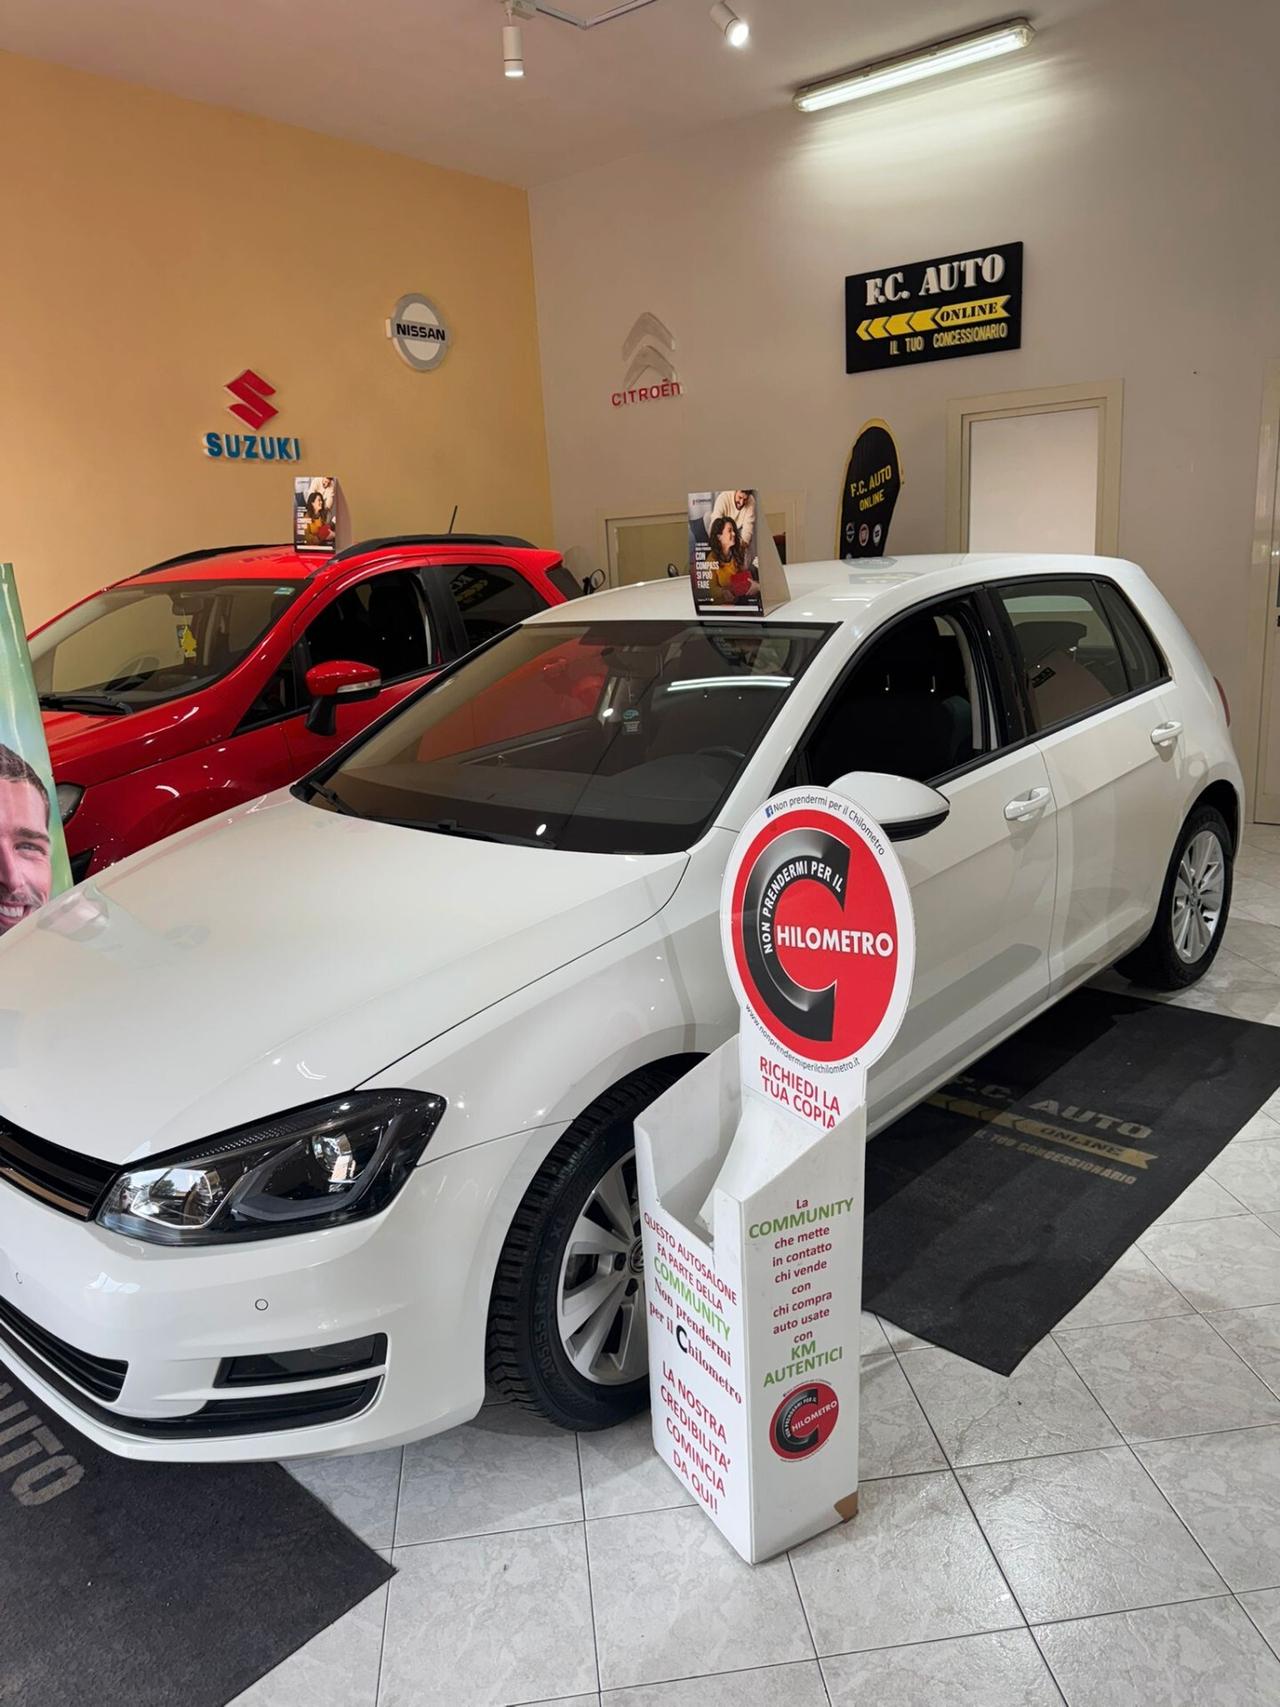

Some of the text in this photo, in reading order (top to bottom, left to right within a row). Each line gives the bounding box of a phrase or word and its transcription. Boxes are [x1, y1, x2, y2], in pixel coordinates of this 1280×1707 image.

[866, 253, 1005, 306] F.C. AUTO
[940, 302, 998, 322] ONLINE
[396, 323, 446, 341] NISSAN
[889, 322, 1008, 355] IL TUO CONCESSIONARIO
[204, 432, 301, 460] SUZUKI
[850, 465, 892, 497] F.C. AUTO
[859, 489, 886, 511] ONLINE
[696, 552, 706, 560] CON
[696, 561, 720, 570] COMPASS
[697, 580, 710, 589] FARE
[773, 794, 885, 856] Non prendermi per il Chilometro
[761, 860, 844, 955] NON PRENDERMI PER IL
[746, 1004, 861, 1075] www.nonprendermiperilchilometro.it
[760, 1056, 841, 1115] RICHIEDI LA
[762, 1075, 836, 1129] TUA COPIA
[1029, 1099, 1152, 1139] AUTO
[1040, 1127, 1121, 1156] ONLINE
[1016, 1141, 1137, 1185] CONCESSIONARIO
[749, 1198, 854, 1239] COMMUNITY
[796, 1199, 808, 1209] La
[772, 1242, 832, 1267] in contatto
[774, 1226, 830, 1250] che mette
[644, 1212, 737, 1306] QUESTO AUTOSALONE
[775, 1260, 827, 1284] chi vende
[657, 1243, 724, 1314] FA PARTE DELLA
[791, 1282, 811, 1295] con
[654, 1256, 731, 1342] COMMUNITY
[772, 1291, 832, 1318] chi compra
[655, 1277, 732, 1367] Non prendermi
[772, 1308, 830, 1335] auto usate
[793, 1330, 813, 1344] con
[649, 1301, 743, 1405] per il Chilometro
[763, 1346, 843, 1387] AUTENTICI
[791, 1340, 816, 1361] KM
[663, 1360, 728, 1445] LA NOSTRA
[660, 1385, 732, 1473] CREDIBILITA'
[666, 1417, 726, 1497] COMINCIA
[673, 1450, 718, 1514] DA QUI!
